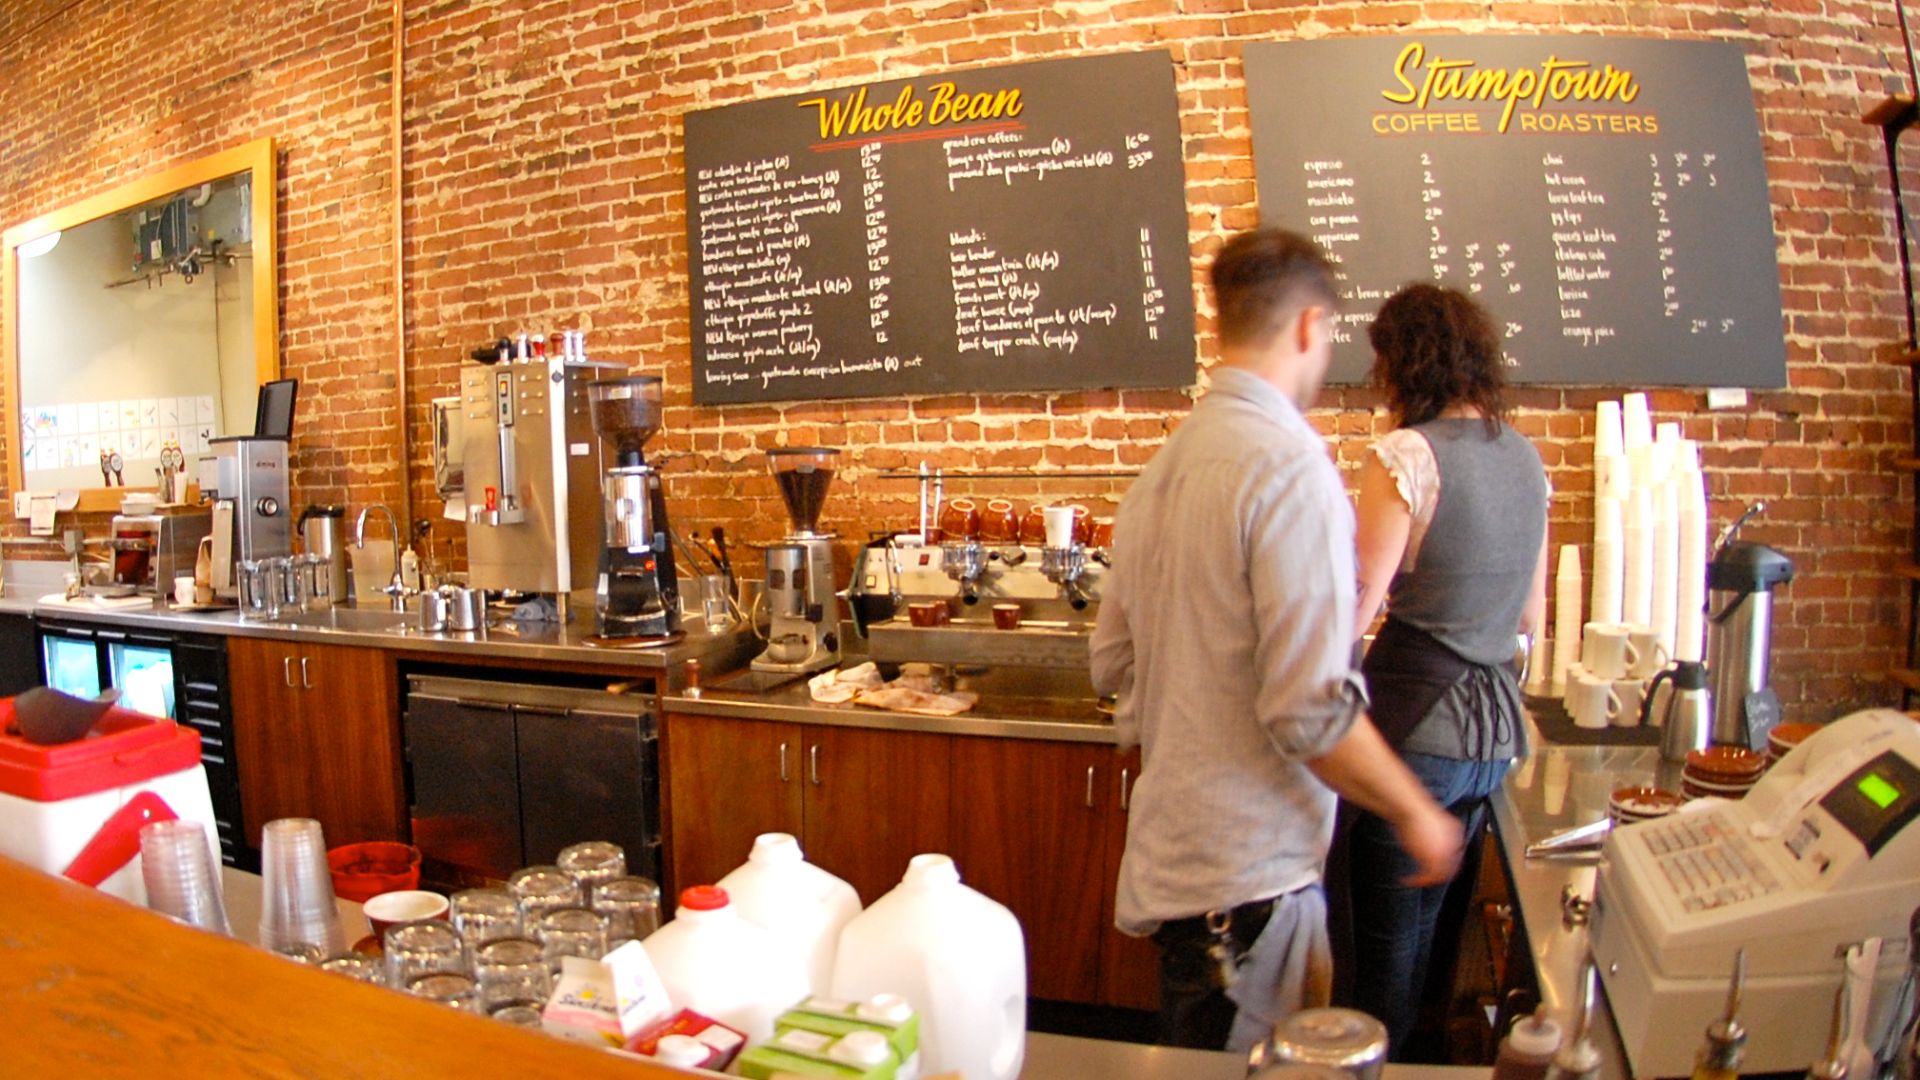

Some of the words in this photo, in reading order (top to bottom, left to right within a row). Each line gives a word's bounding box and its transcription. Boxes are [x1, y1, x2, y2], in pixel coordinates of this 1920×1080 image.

[1380, 40, 1641, 134] Stumptown
[799, 86, 924, 139] Whole
[927, 81, 1024, 126] Bean
[1371, 112, 1481, 134] COFFEE
[1519, 112, 1660, 134] ROASTERS
[1420, 153, 1433, 166] 2
[1422, 171, 1436, 184] 2
[1652, 172, 1664, 187] 2
[1657, 208, 1670, 223] 2
[1430, 226, 1441, 242] 3
[803, 304, 816, 316] 2
